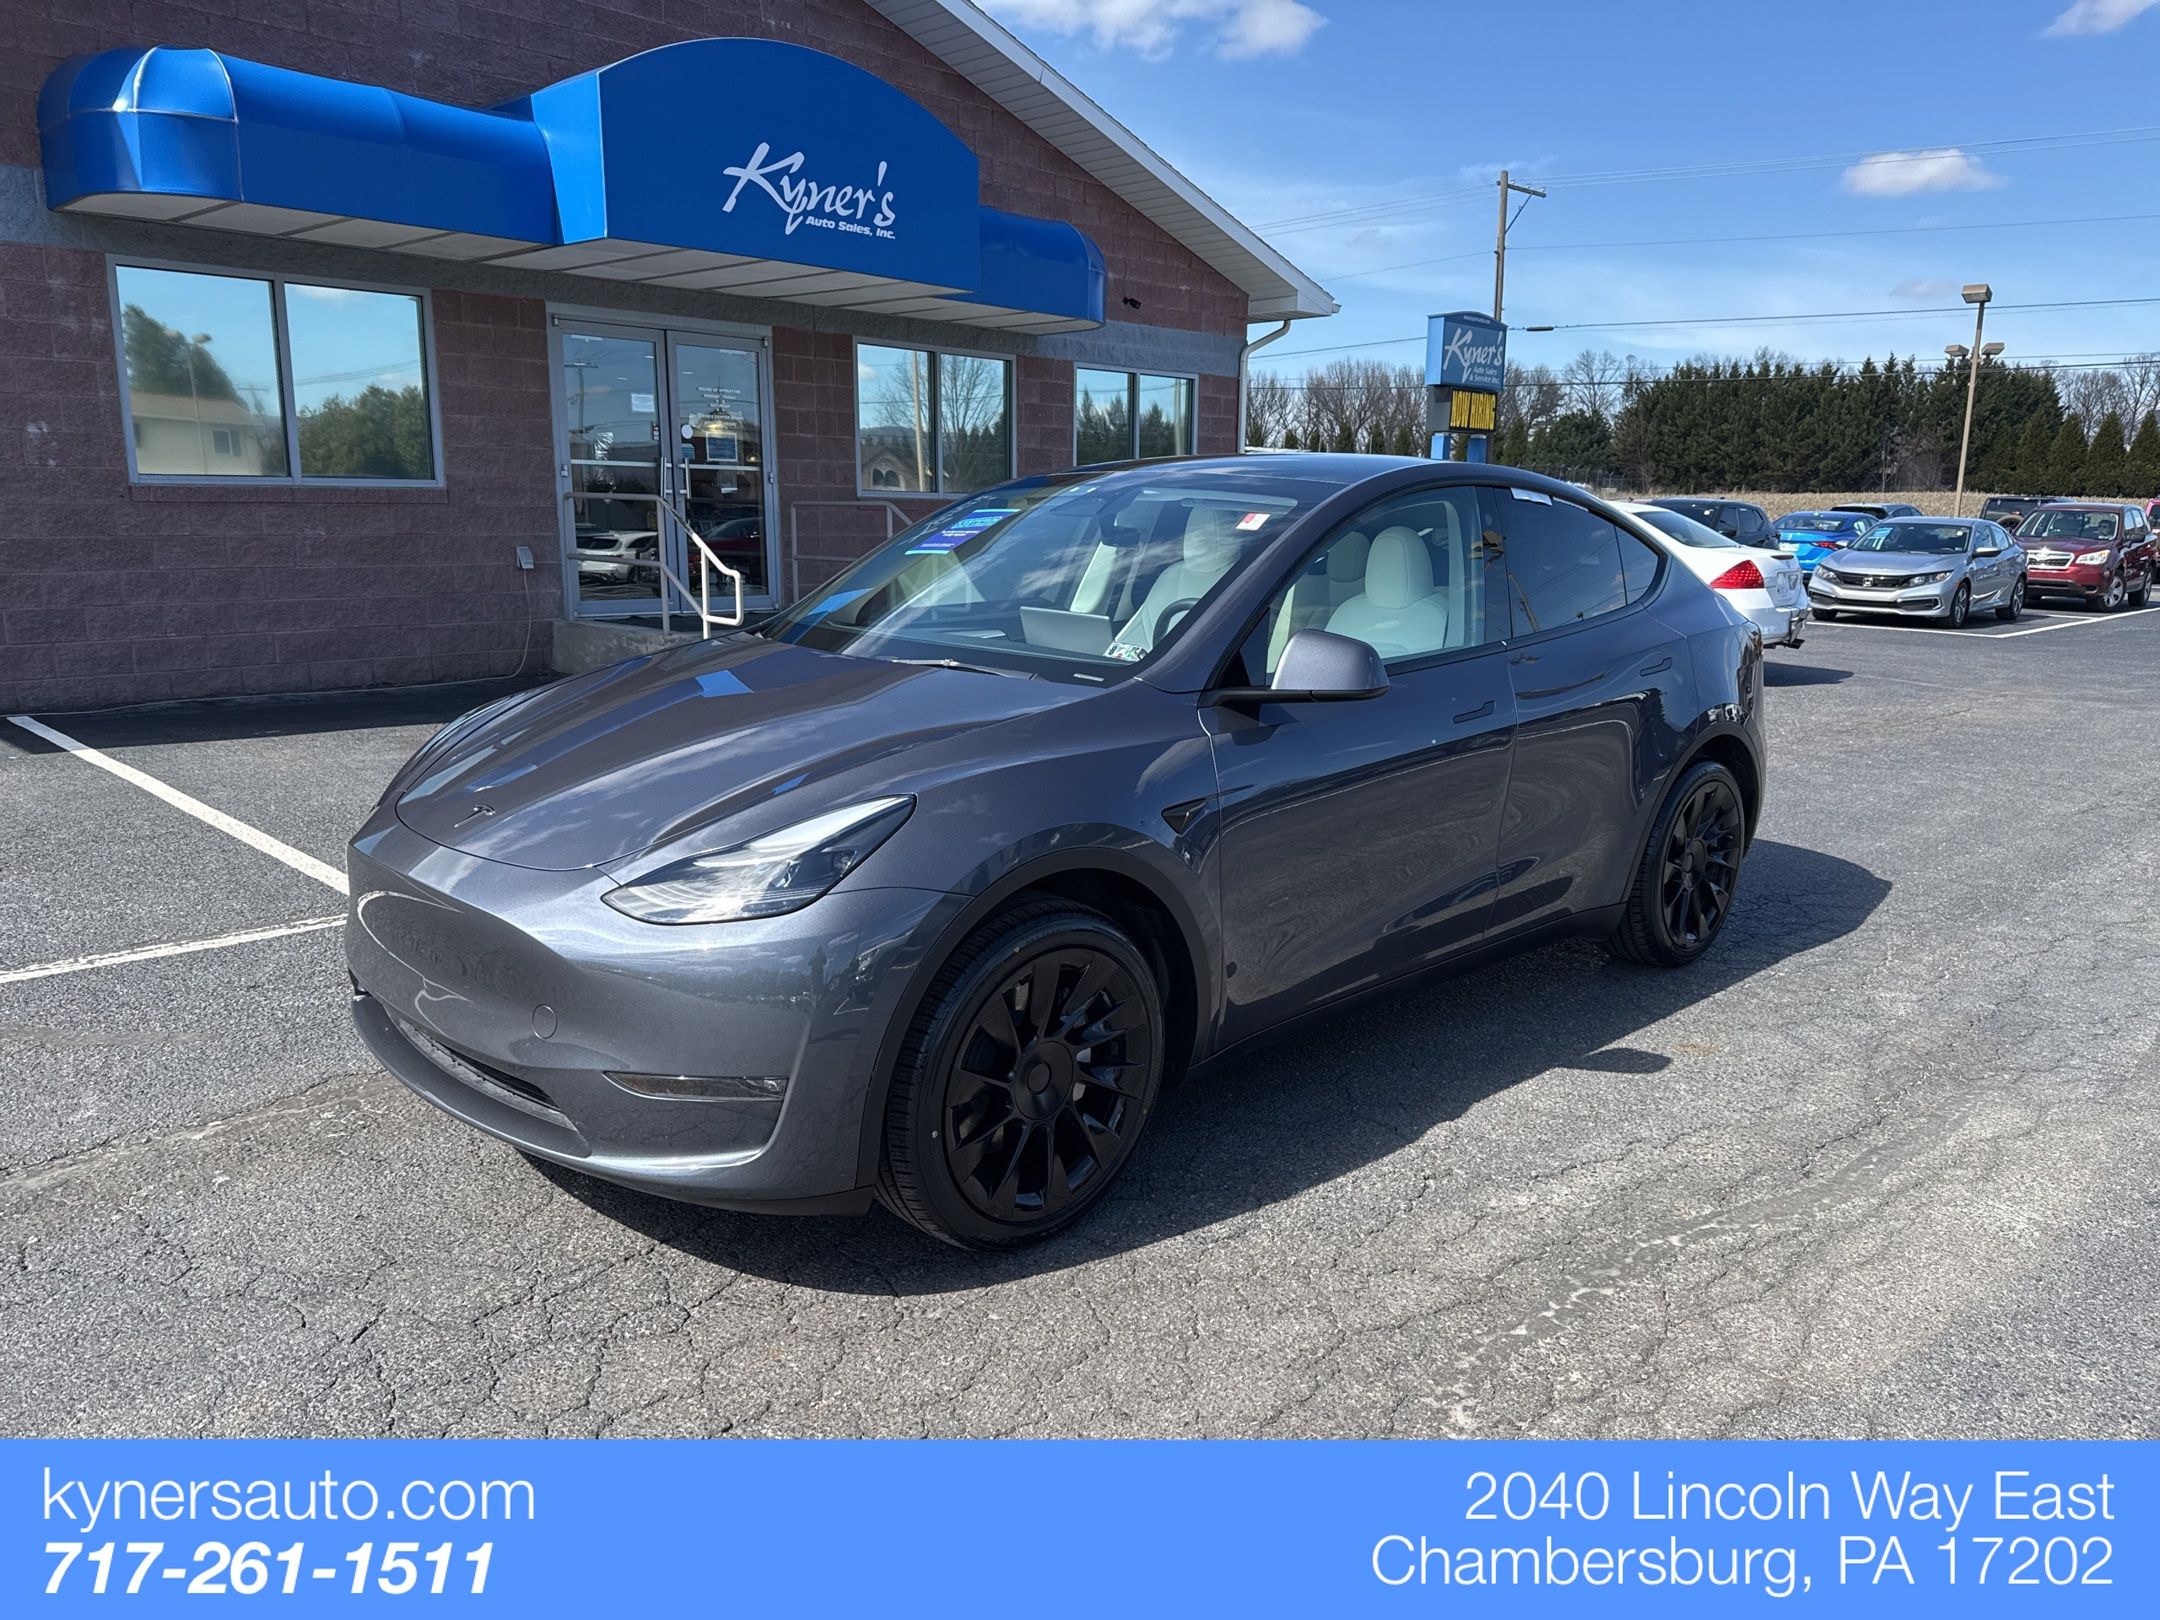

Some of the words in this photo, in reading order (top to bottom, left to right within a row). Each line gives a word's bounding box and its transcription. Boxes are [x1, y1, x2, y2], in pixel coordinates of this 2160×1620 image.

[722, 141, 896, 236] Kyner's
[805, 215, 836, 229] Auto
[837, 221, 873, 237] Sales,
[876, 227, 896, 240] Inc.
[1443, 328, 1503, 383] Kyner's
